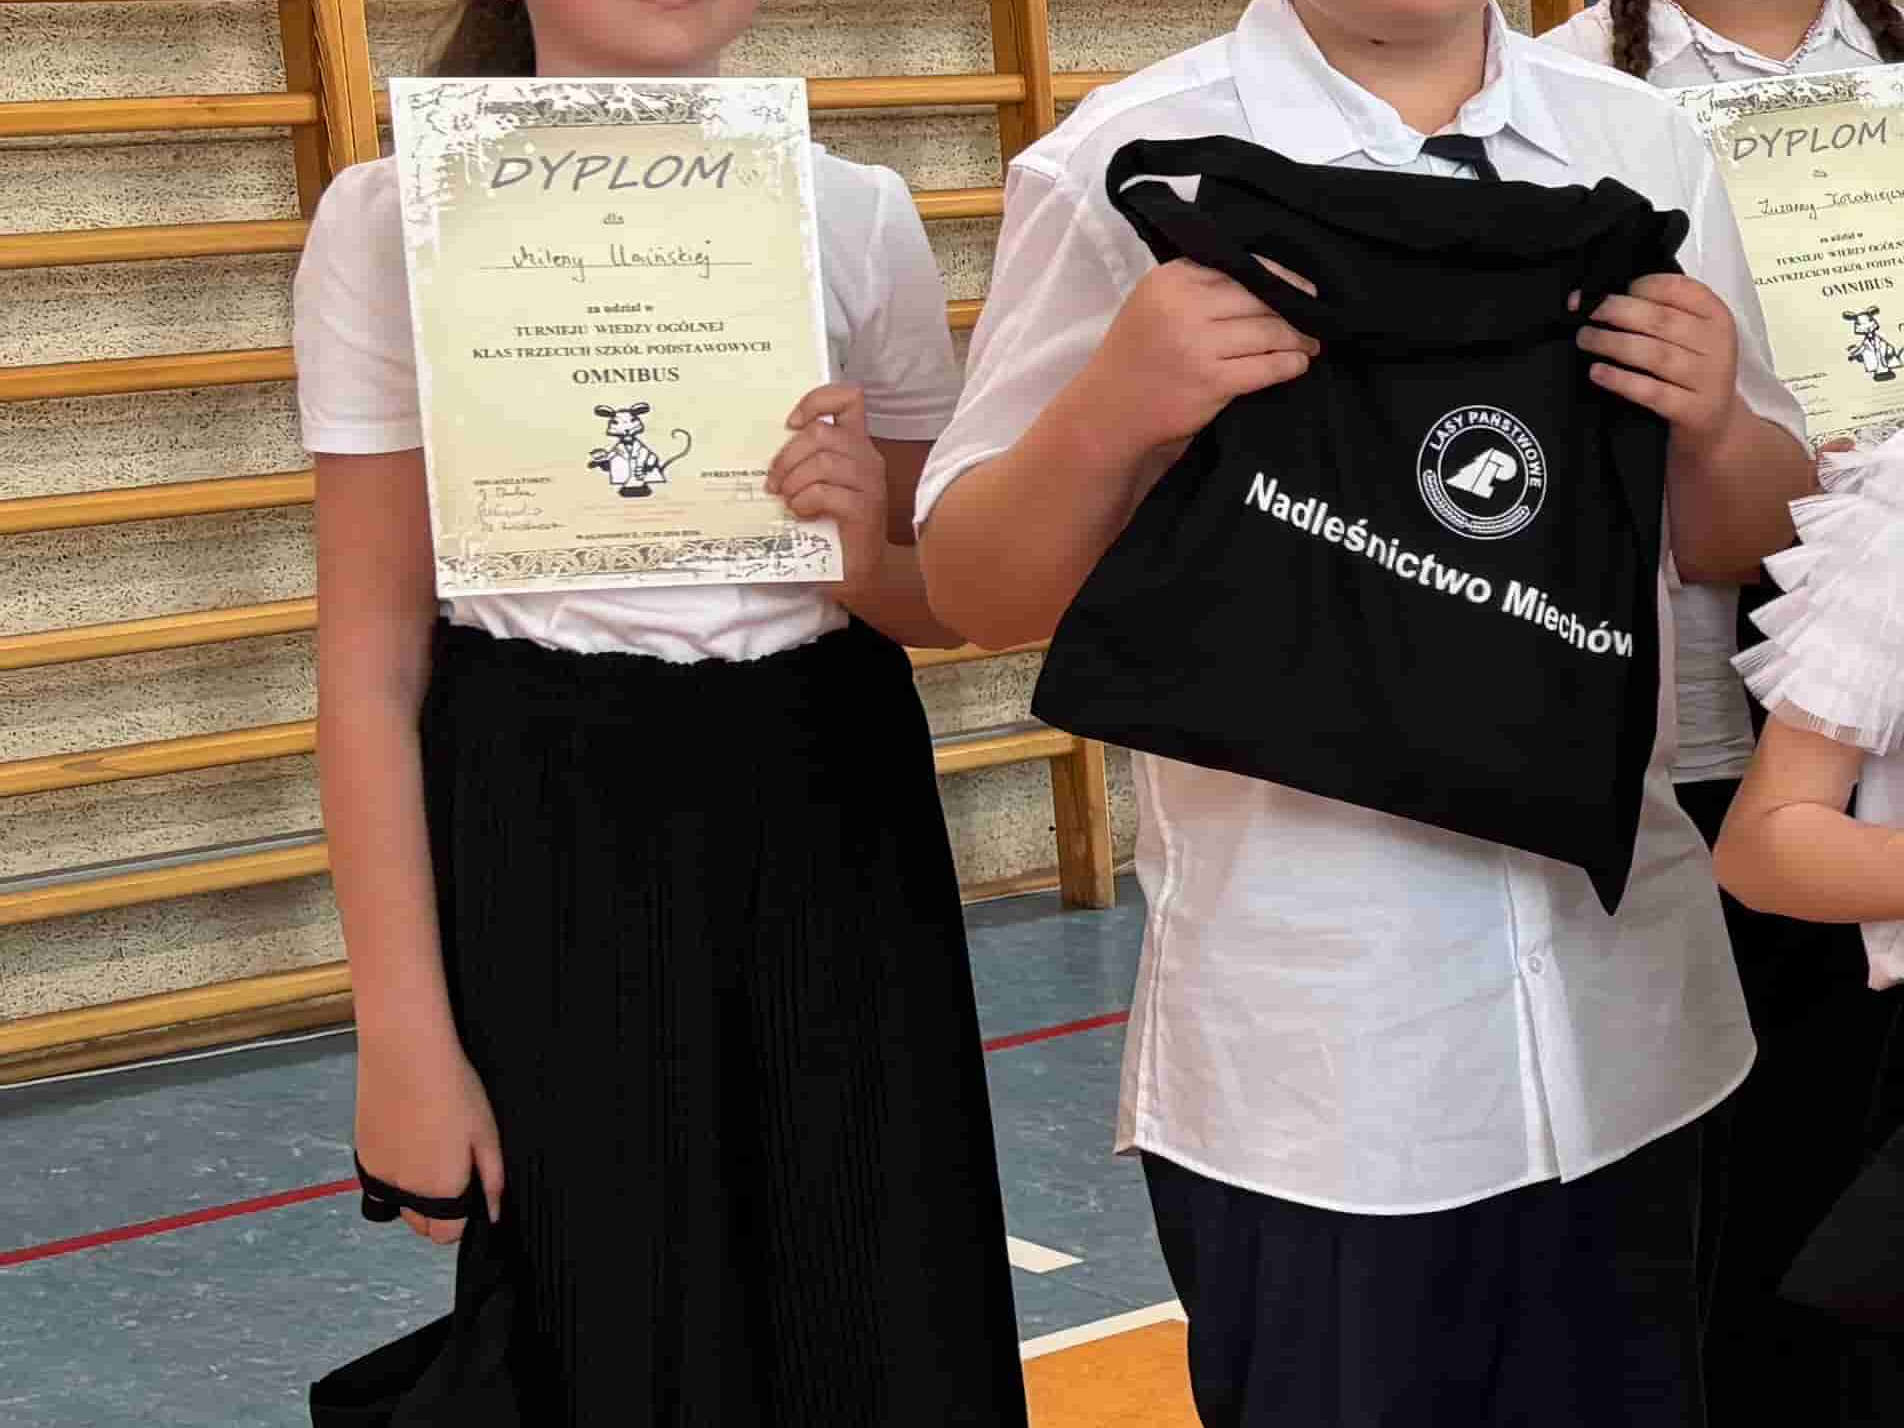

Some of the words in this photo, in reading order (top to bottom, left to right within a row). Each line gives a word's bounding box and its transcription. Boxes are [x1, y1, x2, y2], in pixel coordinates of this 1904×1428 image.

[1734, 117, 1887, 161] DYPLOM
[491, 150, 734, 191] DYPLOM
[1822, 276, 1894, 297] OMNIBUS
[514, 325, 588, 337] TURNIEJU
[595, 323, 652, 334] WIEDZY
[657, 321, 723, 333] OGÓLNEJ
[473, 348, 513, 359] KLAS
[517, 346, 590, 358] TRZECICH
[595, 342, 643, 356] SZKÓŁ
[647, 341, 771, 355] PODSTAWOWYCH
[572, 367, 680, 384] OMNIBUS
[1429, 414, 1463, 451] LASY
[1244, 472, 1493, 605] Nadleśnictwo
[1501, 579, 1633, 659] Miechów
